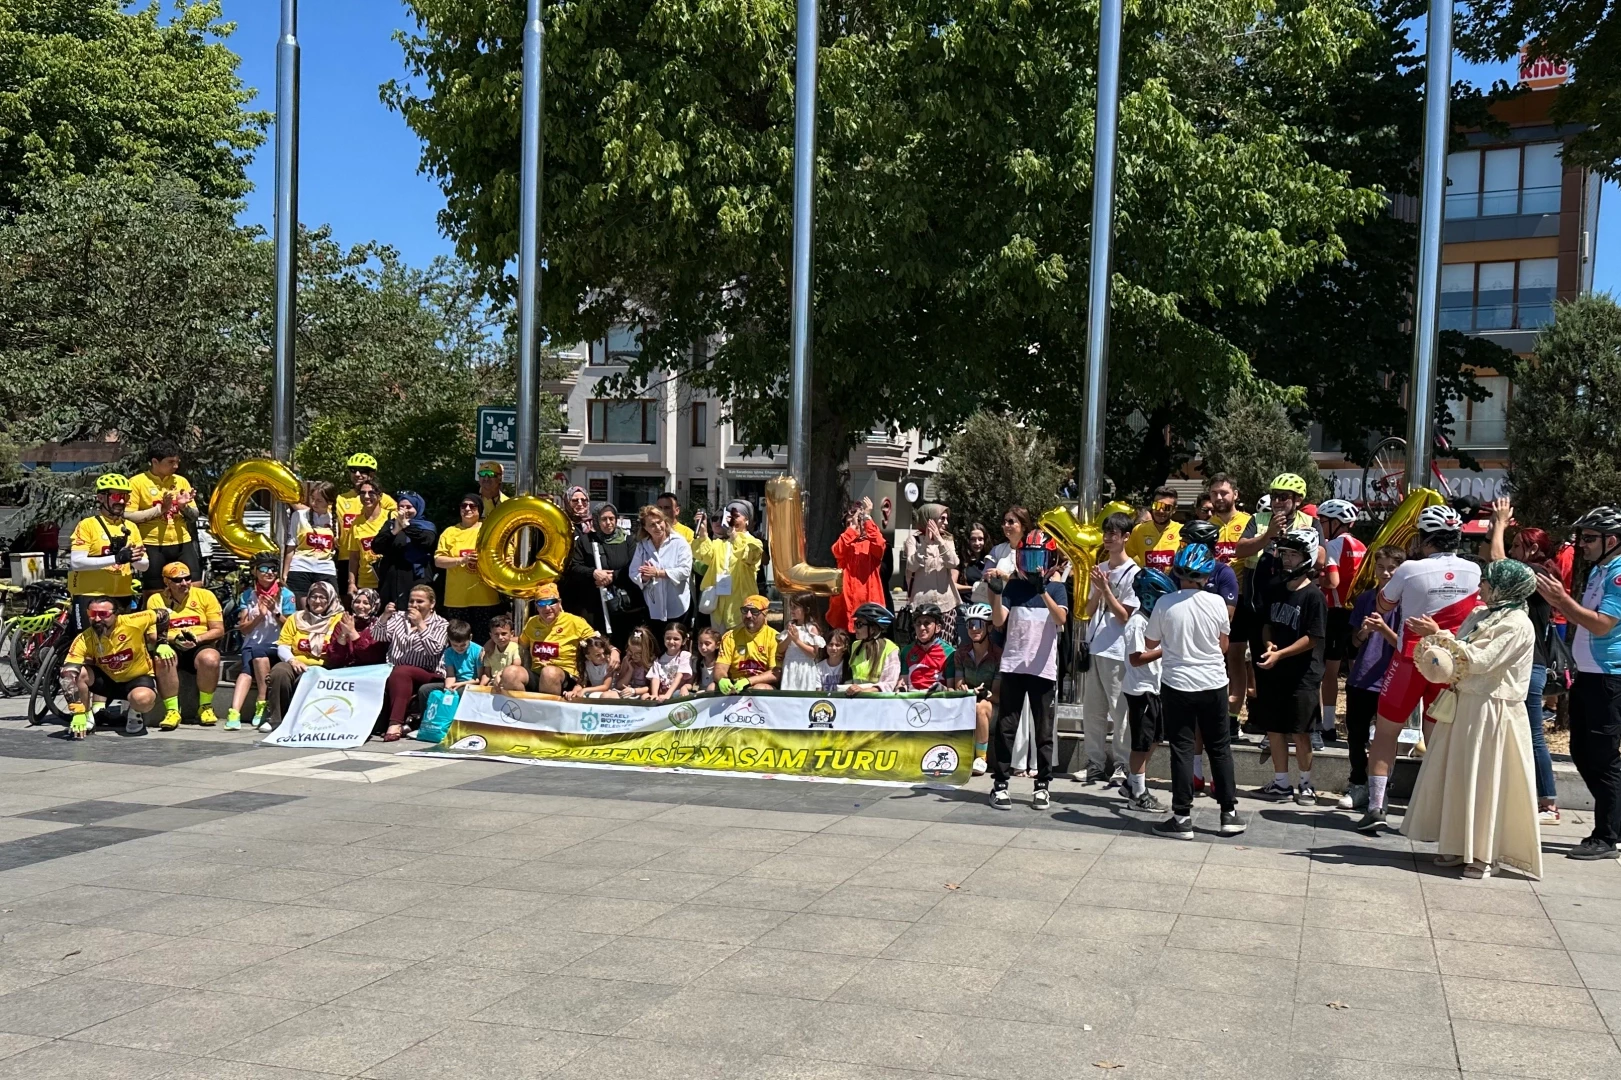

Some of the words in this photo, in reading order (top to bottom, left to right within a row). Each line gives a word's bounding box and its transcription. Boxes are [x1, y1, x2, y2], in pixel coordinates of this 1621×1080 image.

[1520, 63, 1568, 79] KING
[1146, 554, 1173, 565] Schär
[534, 645, 557, 655] Schär
[317, 679, 355, 692] DÜZCE
[813, 750, 898, 772] TURU
